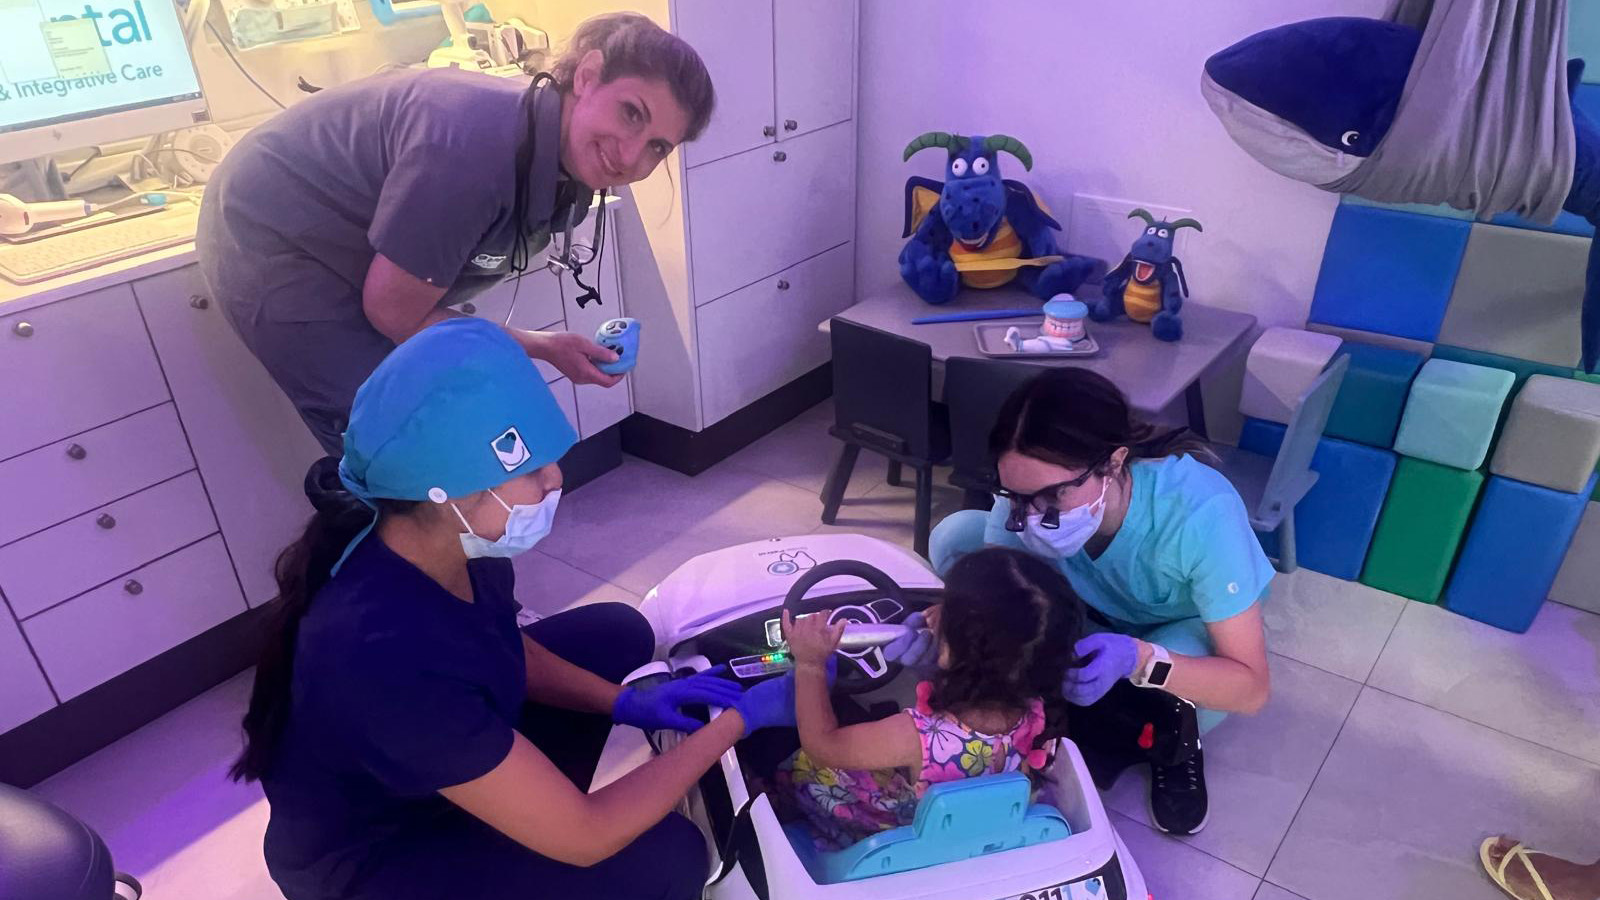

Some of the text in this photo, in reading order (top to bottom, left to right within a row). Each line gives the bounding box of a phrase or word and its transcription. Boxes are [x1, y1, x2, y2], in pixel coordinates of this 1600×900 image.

[51, 0, 152, 46] tal
[15, 72, 117, 97] Integrative
[121, 64, 163, 82] Care
